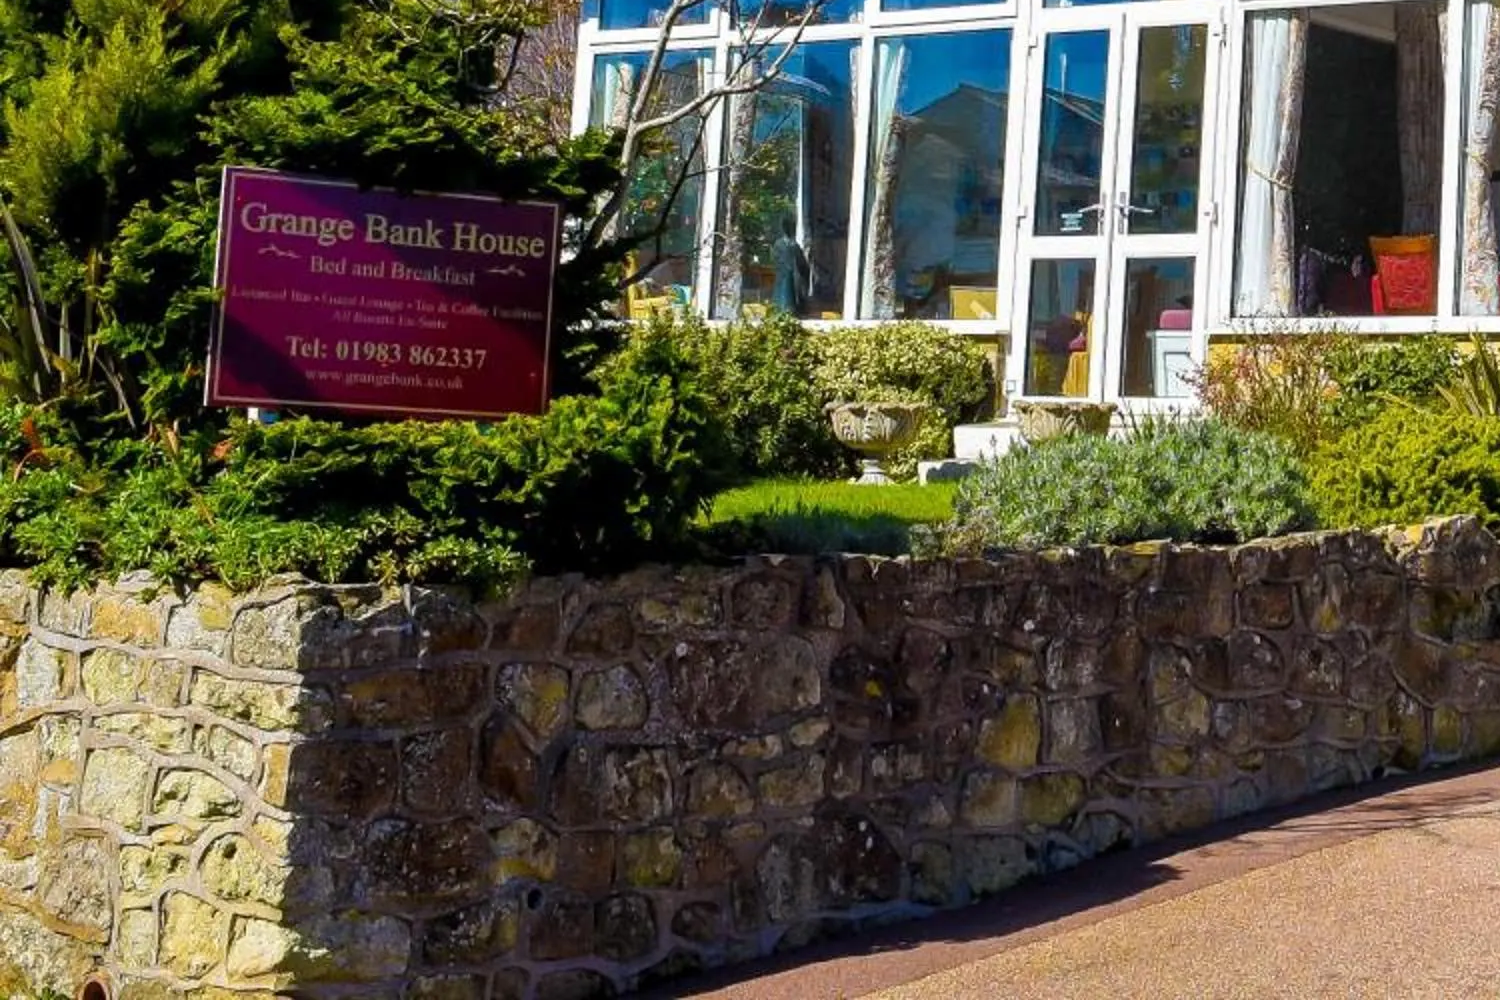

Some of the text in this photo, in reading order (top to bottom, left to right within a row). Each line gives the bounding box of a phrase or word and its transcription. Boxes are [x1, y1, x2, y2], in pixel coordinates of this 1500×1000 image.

[240, 202, 545, 259] Grange Bank House
[310, 255, 476, 286] Bed and Breakfast
[451, 301, 489, 318] Coffee
[285, 335, 487, 370] Tel: 01983 862337
[304, 368, 463, 390] www.grangebank.co.uk
